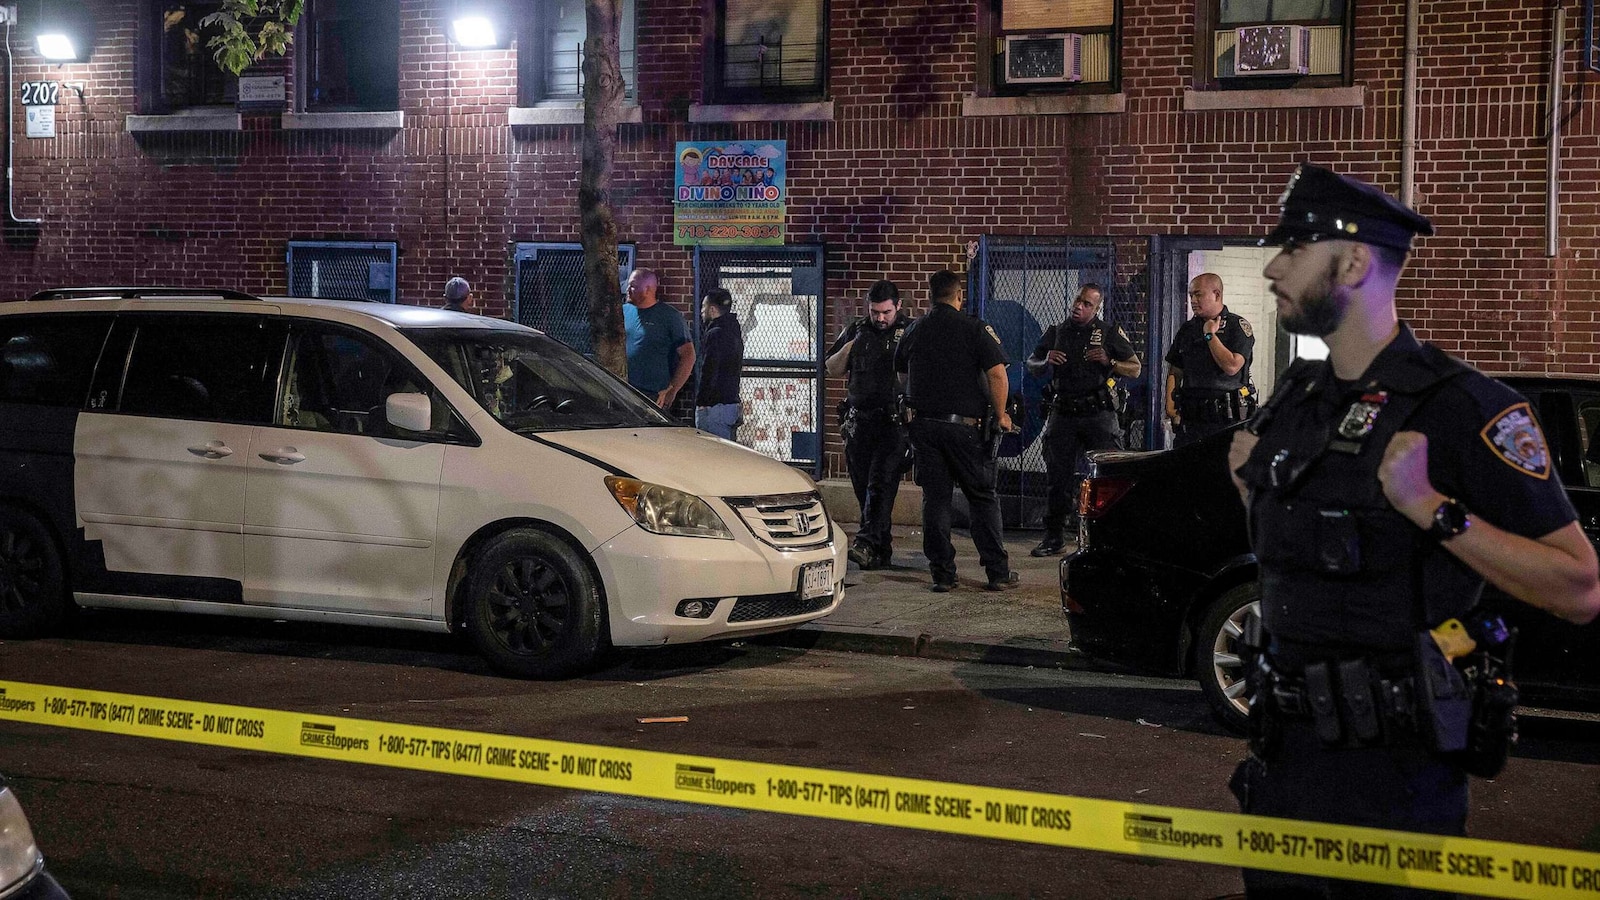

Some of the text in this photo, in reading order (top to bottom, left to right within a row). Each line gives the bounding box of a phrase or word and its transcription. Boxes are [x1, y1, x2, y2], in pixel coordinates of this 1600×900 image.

[21, 82, 59, 104] 2707
[707, 154, 769, 169] DAYCARE
[679, 185, 734, 201] DIVINO
[679, 225, 780, 238] 718-220-3034
[43, 697, 108, 721] 1-800-577-TIPS
[108, 701, 135, 725] (8477)
[138, 707, 166, 727] CRIME
[166, 710, 194, 731] SCENE
[202, 714, 216, 732] DO
[216, 716, 235, 735] NOT
[235, 718, 265, 739] CROSS
[379, 734, 451, 760] 1-800-577-TIPS
[452, 740, 482, 765] (8477)
[486, 746, 517, 768] CRIME
[518, 750, 550, 771] SCENE
[561, 755, 575, 774] DO
[577, 756, 597, 777] NOT
[600, 759, 632, 781] CROSS
[766, 777, 852, 807] 1-800-577-TIPS
[855, 785, 890, 812] (8477)
[895, 791, 931, 815] CRIME
[934, 795, 972, 819] SCENE
[985, 801, 1001, 823] DO
[1005, 803, 1029, 826] NOT
[1031, 805, 1072, 831] CROSS
[1236, 828, 1344, 862] 1-800-577-TIPS
[1346, 838, 1392, 869] (8477)
[1397, 846, 1444, 873] CRIME
[1447, 851, 1495, 879] SCENE
[1512, 859, 1533, 884] DO
[1537, 861, 1567, 888] NOT
